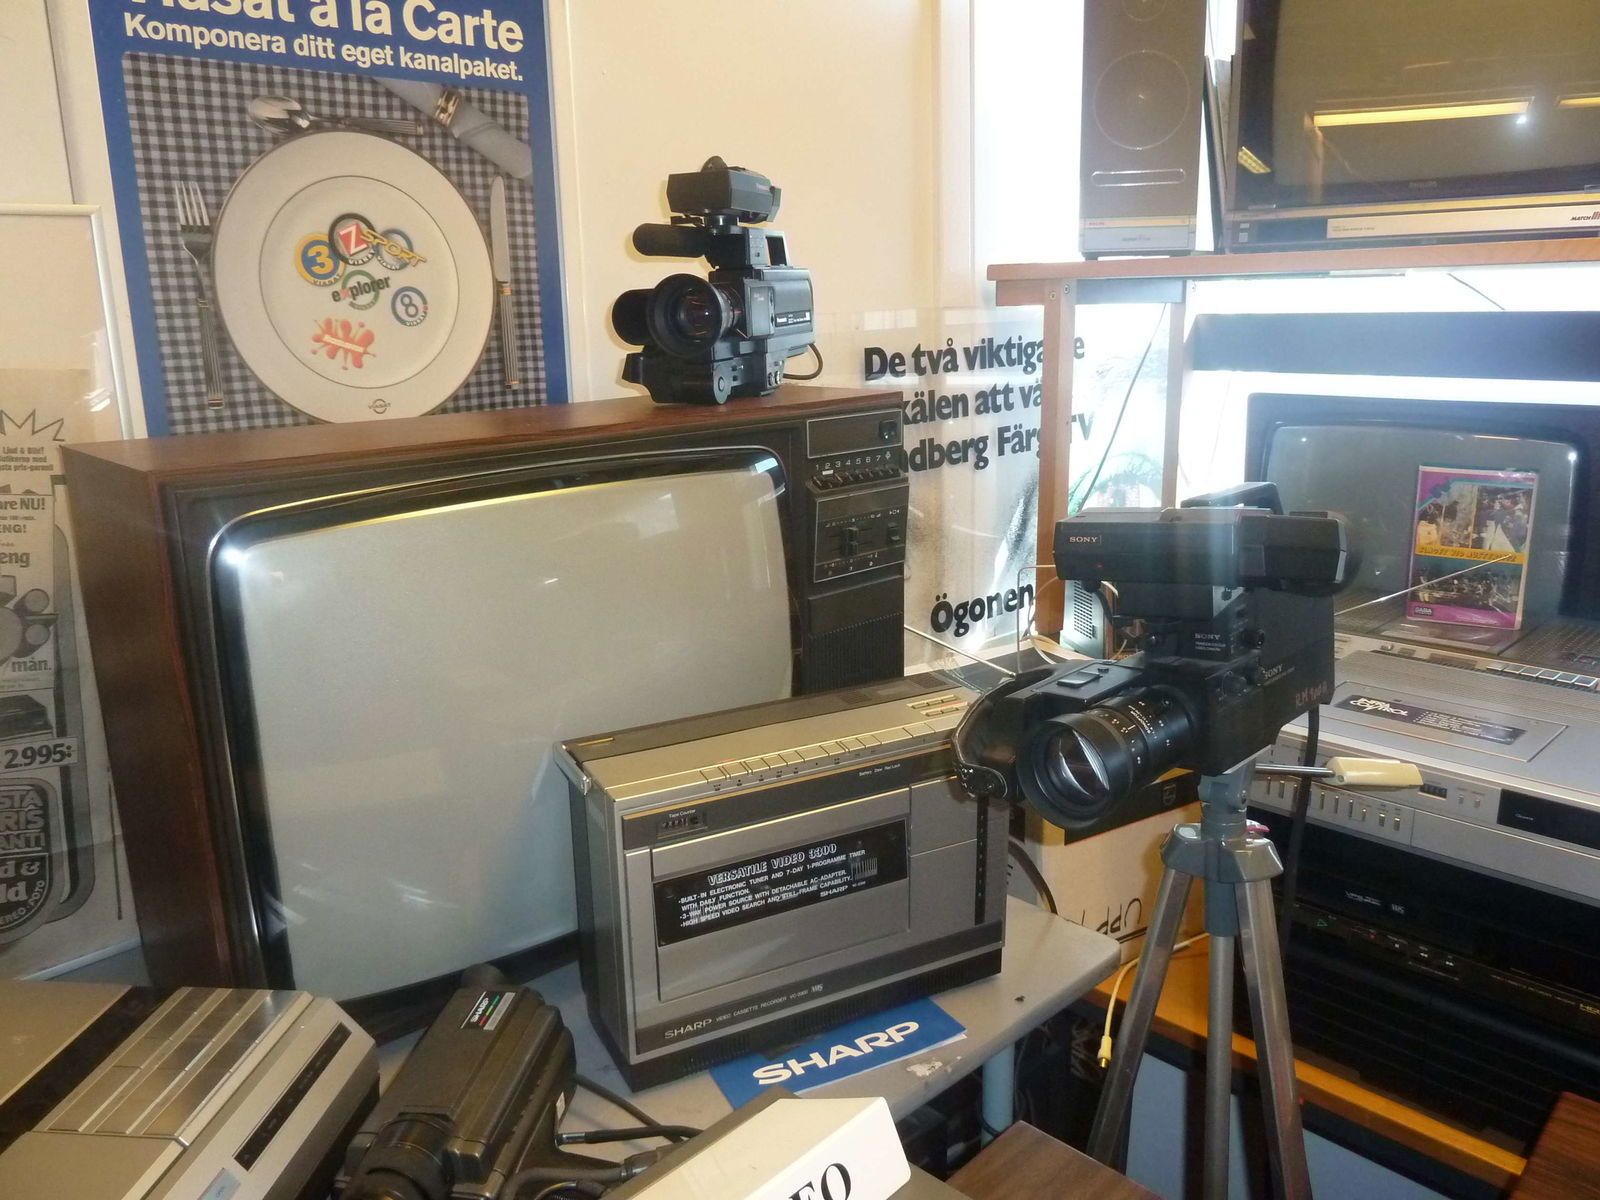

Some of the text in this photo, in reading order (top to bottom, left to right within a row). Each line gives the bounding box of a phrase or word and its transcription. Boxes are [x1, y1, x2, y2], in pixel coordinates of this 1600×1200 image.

[351, 0, 393, 35] la
[402, 0, 524, 53] Carte
[124, 12, 524, 81] Komponera ditt eget kanalpaket.
[339, 224, 368, 256] Z
[360, 229, 427, 267] SPORT
[307, 245, 334, 275] 3
[331, 276, 391, 302] explorer
[400, 294, 419, 318] 8
[864, 347, 906, 381] De
[911, 338, 959, 376] två
[974, 381, 1015, 415] att
[20, 497, 46, 511] NU!
[0, 524, 27, 533] NG!
[931, 583, 1034, 637] Ögonen
[707, 843, 837, 886] VERSATILE VIDEO 3300
[709, 881, 747, 896] ELECTRONIC
[749, 875, 769, 885] TUNER
[771, 871, 784, 880] AND
[786, 866, 804, 876] 7-DAY
[806, 854, 847, 870] 1-PROGRAMME
[849, 849, 866, 858] TIMER
[681, 888, 750, 911] WITH DAILY FUNCTION.
[700, 911, 720, 923] SPEED
[721, 906, 740, 916] VIDEO
[741, 899, 766, 911] SEARCH
[767, 895, 780, 904] AND
[819, 875, 853, 889] CAPABILITY.
[704, 902, 727, 914] POWER
[728, 895, 753, 907] SOURCE
[754, 890, 770, 900] WITH
[771, 880, 808, 895] DETACHABLE
[820, 885, 849, 898] SHARP
[470, 997, 489, 1022] SHARP
[664, 1018, 713, 1040] SHARP
[715, 1014, 732, 1023] VIDEO
[733, 1004, 759, 1018] CASSETTE
[760, 995, 787, 1009] RECORDER
[752, 1021, 920, 1085] SHARP
